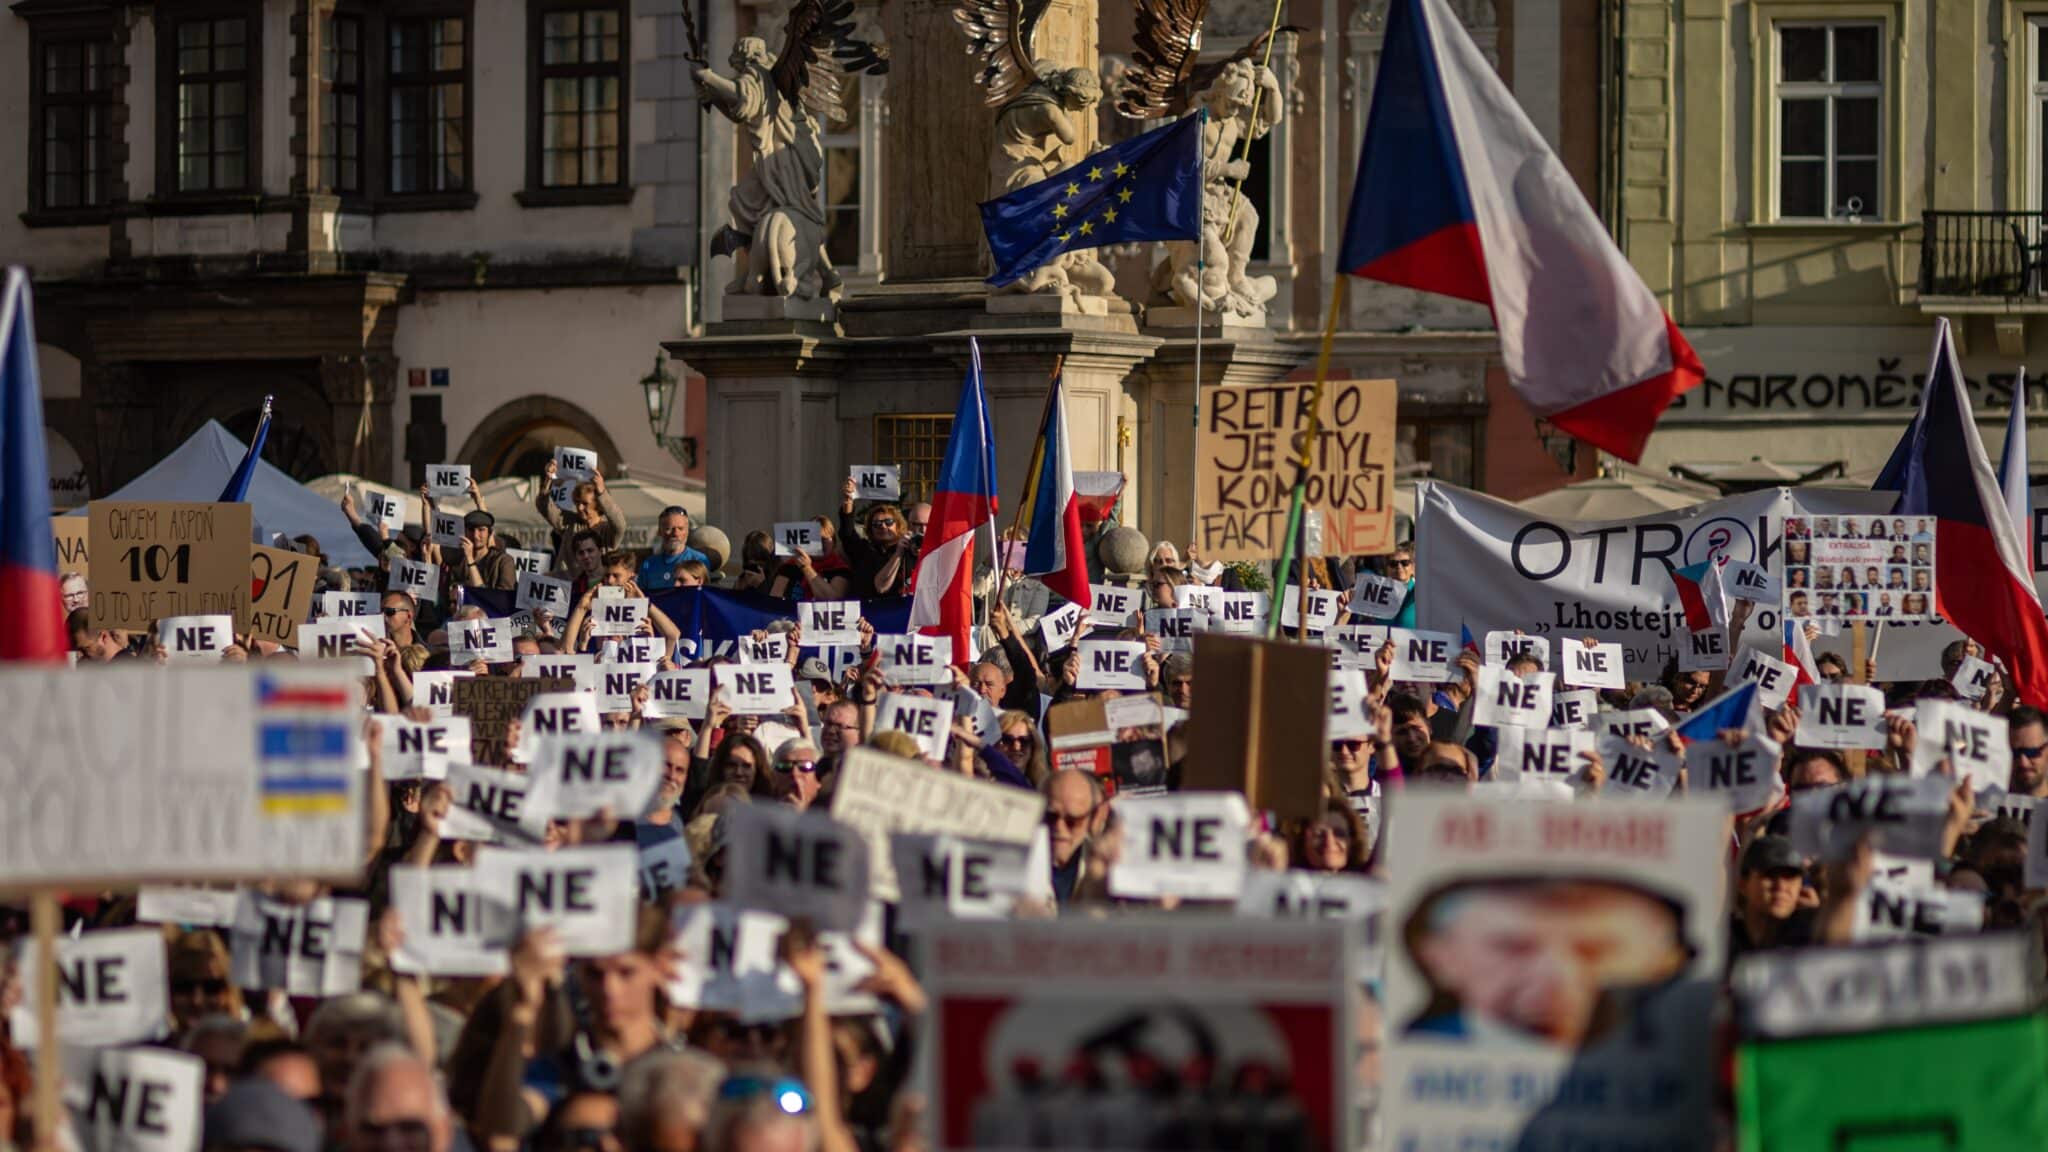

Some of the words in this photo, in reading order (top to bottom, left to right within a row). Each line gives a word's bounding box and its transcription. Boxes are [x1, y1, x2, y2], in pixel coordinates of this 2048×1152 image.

[1211, 385, 1361, 434] RETRO
[563, 455, 586, 469] NE
[1214, 432, 1274, 473] JE
[1286, 431, 1384, 472] STYL
[437, 472, 459, 486] NE
[862, 472, 887, 488] NE
[372, 500, 396, 517] NE
[169, 506, 214, 541] ASPOŇ
[436, 519, 455, 535] NE
[1201, 510, 1285, 552] FAKT
[786, 529, 810, 545] NE
[120, 543, 190, 584] 101
[516, 558, 539, 572] NE
[401, 568, 427, 585] NE
[1736, 569, 1768, 589] NE
[529, 582, 558, 602] NE
[1097, 593, 1127, 612] NE
[1364, 582, 1393, 605] NE
[110, 591, 130, 622] TO
[139, 591, 156, 622] SE
[311, 601, 322, 616] N
[338, 600, 367, 616] NE
[605, 606, 635, 622] NE
[1224, 600, 1254, 620] NE
[812, 611, 846, 630] NE
[1159, 618, 1192, 637] NE
[1535, 601, 1687, 638] „Lhostejn
[176, 627, 215, 650] NE
[318, 634, 357, 658] NE
[464, 628, 496, 648] NE
[1692, 633, 1722, 655] NE
[617, 645, 651, 663] NE
[753, 641, 782, 659] NE
[895, 644, 934, 665] NE
[1093, 651, 1129, 672] NE
[1409, 639, 1447, 662] NE
[1576, 650, 1608, 672] NE
[605, 673, 641, 695] NE
[735, 672, 776, 694] NE
[1742, 659, 1781, 690] NE
[654, 679, 691, 700] NE
[1497, 681, 1540, 710] NE
[533, 707, 581, 734] NE
[894, 707, 938, 736] NE
[1550, 700, 1582, 725] NE
[1819, 697, 1866, 726] NE
[397, 727, 448, 754] NE
[1944, 719, 1990, 762] NE
[561, 745, 634, 784] NE
[1521, 743, 1571, 773] NE
[1610, 752, 1660, 790] NE
[1710, 750, 1757, 790] NE
[467, 781, 526, 823] NE
[1150, 817, 1224, 860] NE
[764, 830, 844, 891] NE
[921, 852, 992, 899] NE
[516, 867, 596, 913] NE
[1869, 890, 1948, 935] NE
[261, 914, 334, 958] NE
[55, 956, 129, 1006] NE
[86, 1068, 173, 1135] NE
